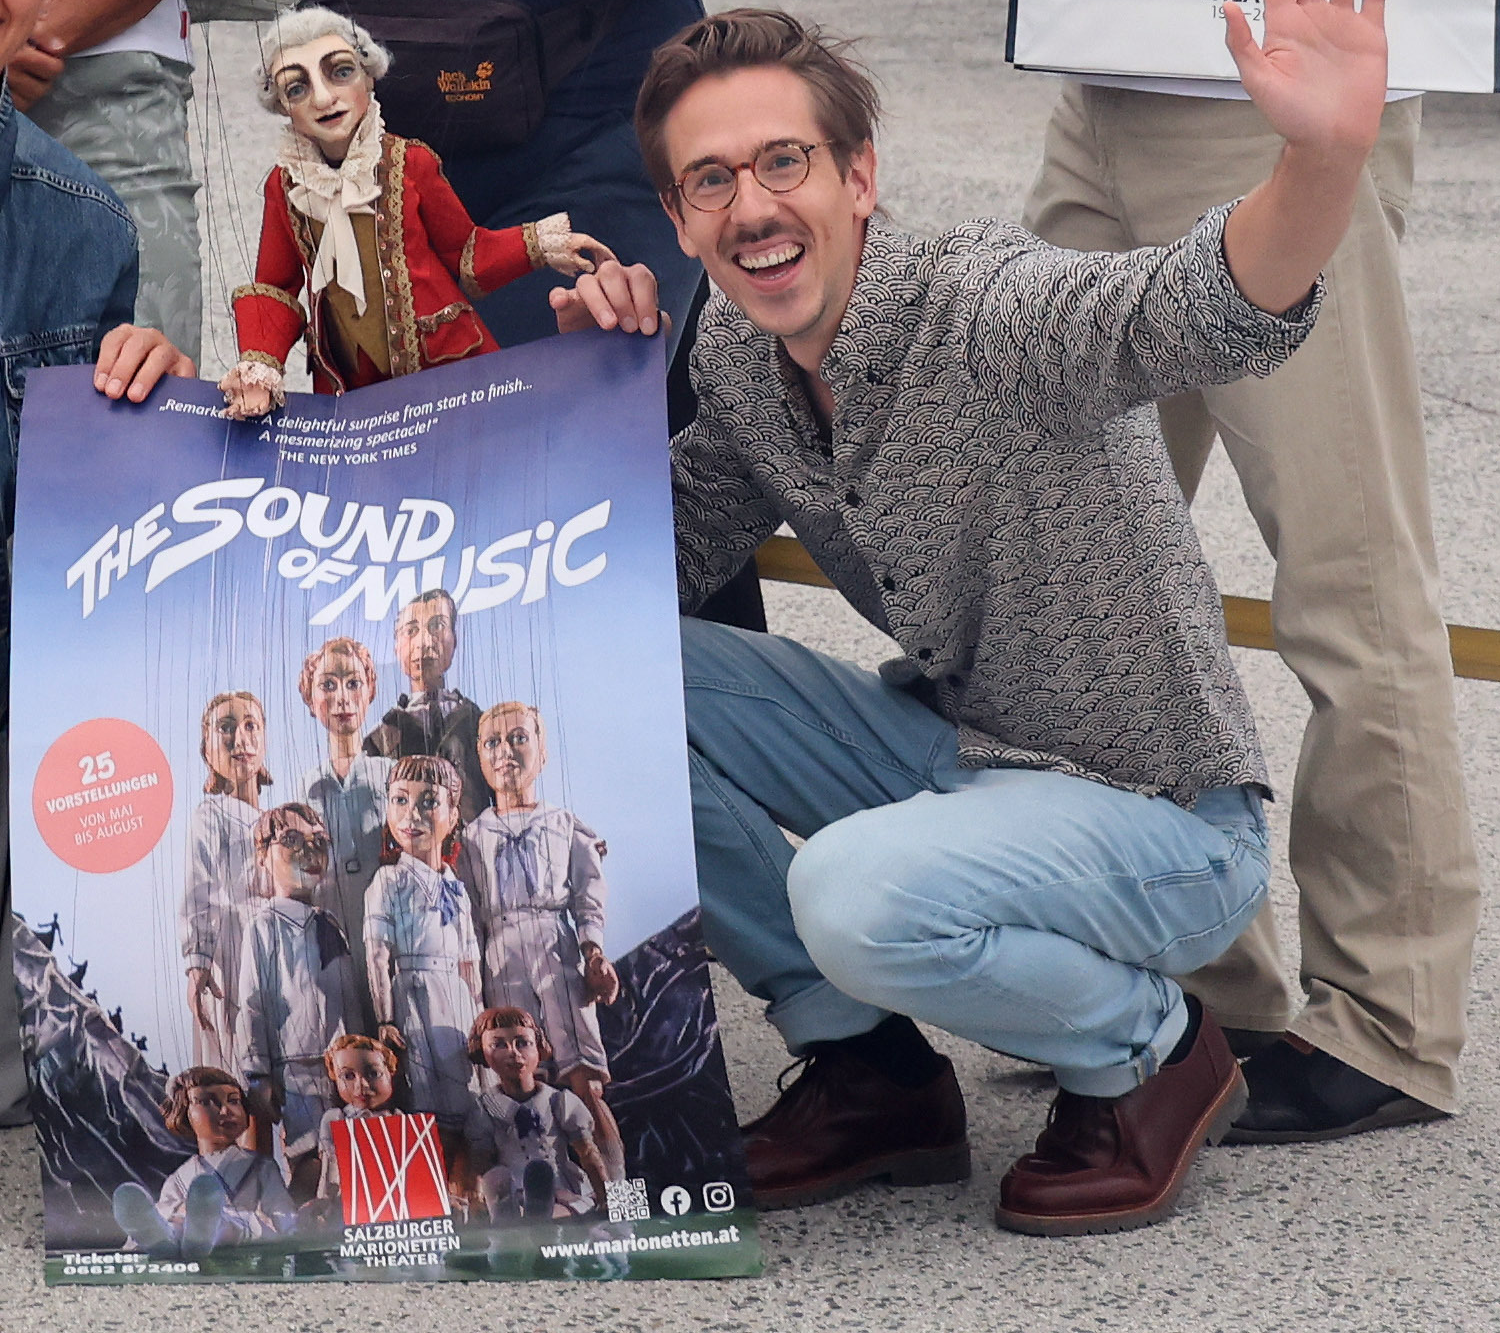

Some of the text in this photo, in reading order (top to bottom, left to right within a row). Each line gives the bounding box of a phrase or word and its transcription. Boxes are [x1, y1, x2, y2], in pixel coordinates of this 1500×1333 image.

[261, 416, 273, 426] A
[277, 415, 346, 435] delightful
[349, 410, 400, 432] surprise
[402, 402, 433, 423] from
[436, 393, 468, 412] start
[470, 389, 485, 404] to
[258, 430, 271, 441] A
[274, 432, 363, 451] mesmerizing
[280, 441, 418, 466] THE NEW YORK TIMES
[66, 477, 455, 619] THE SOUND
[278, 548, 358, 590] OF
[78, 751, 116, 786] 25
[45, 772, 159, 814] VORSTELLUNGEN
[79, 804, 134, 828] VON MAI
[74, 815, 144, 846] BIS AUGUST
[343, 1219, 455, 1244] SALZBURGER
[540, 1224, 740, 1259] www.marionetten.at
[62, 1252, 139, 1265] Tickets:
[340, 1235, 461, 1258] MARIONETTEN
[63, 1262, 200, 1275] 0662 872406
[363, 1252, 439, 1268] THEATER
